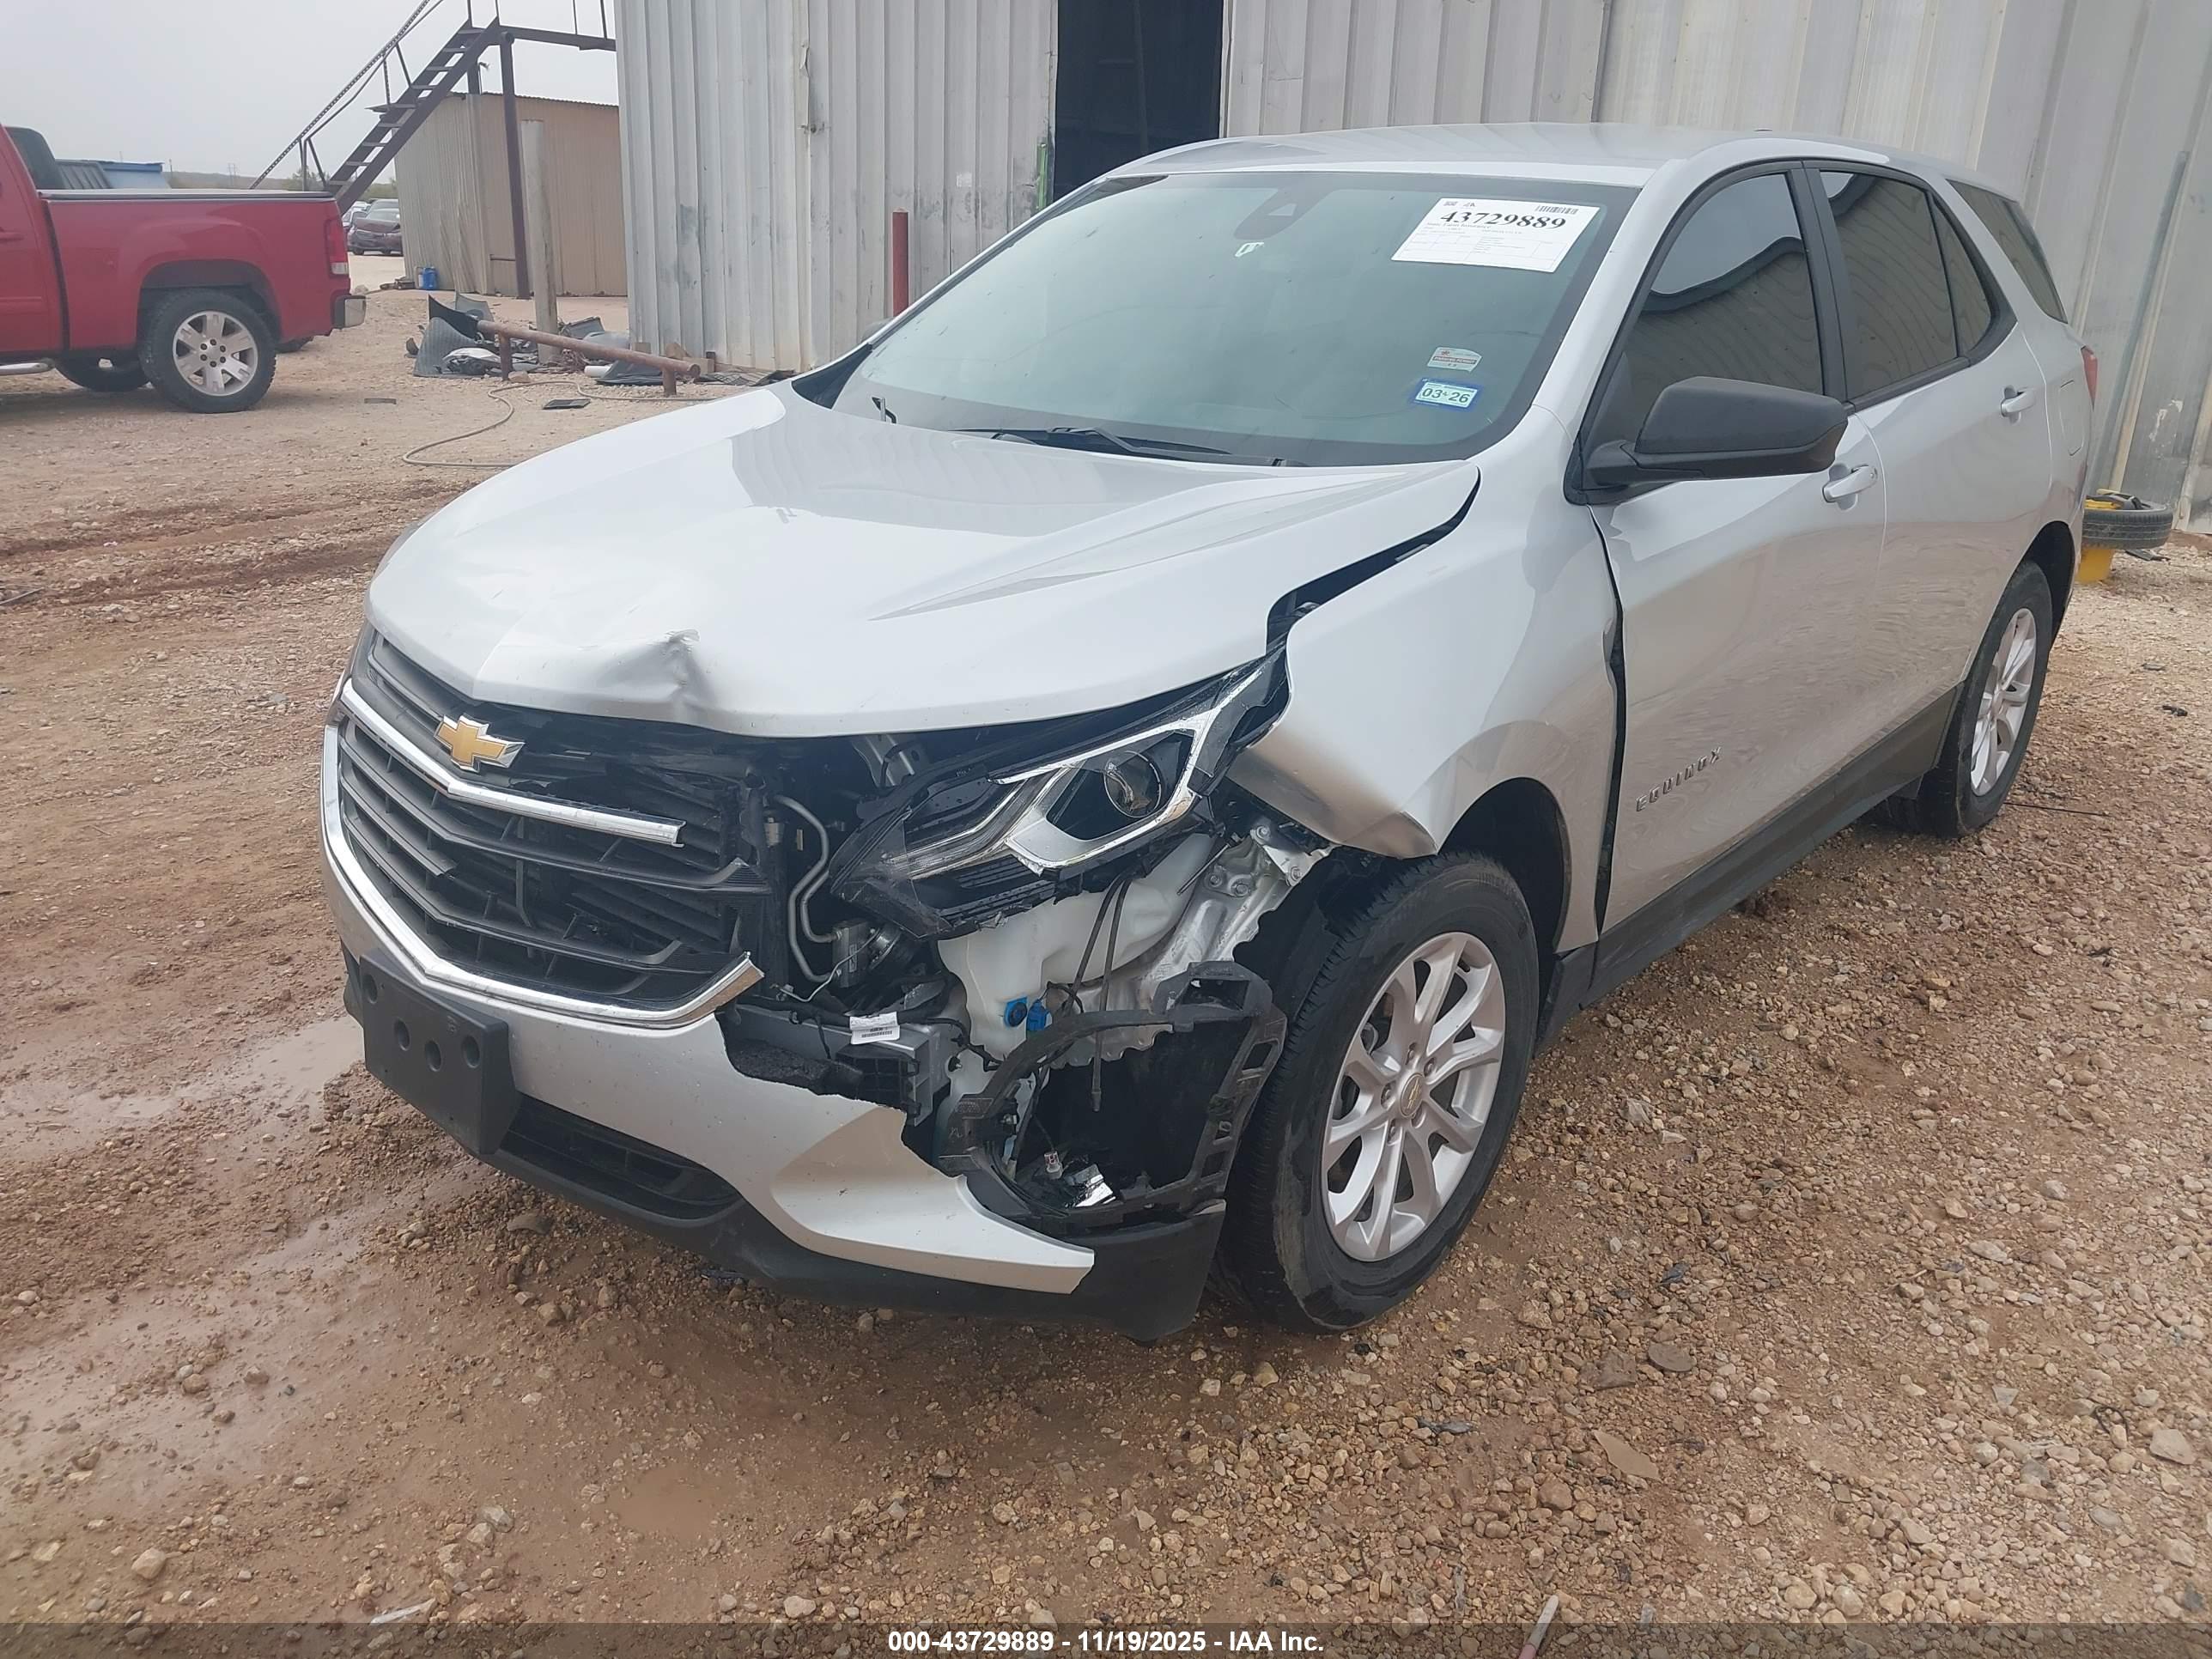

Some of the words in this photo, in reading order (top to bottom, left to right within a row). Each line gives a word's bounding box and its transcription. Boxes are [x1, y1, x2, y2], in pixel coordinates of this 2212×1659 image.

[1440, 210, 1566, 229] 43729889
[1422, 387, 1443, 398] 03
[1449, 392, 1471, 404] 26
[1636, 746, 1722, 811] EQUINOX
